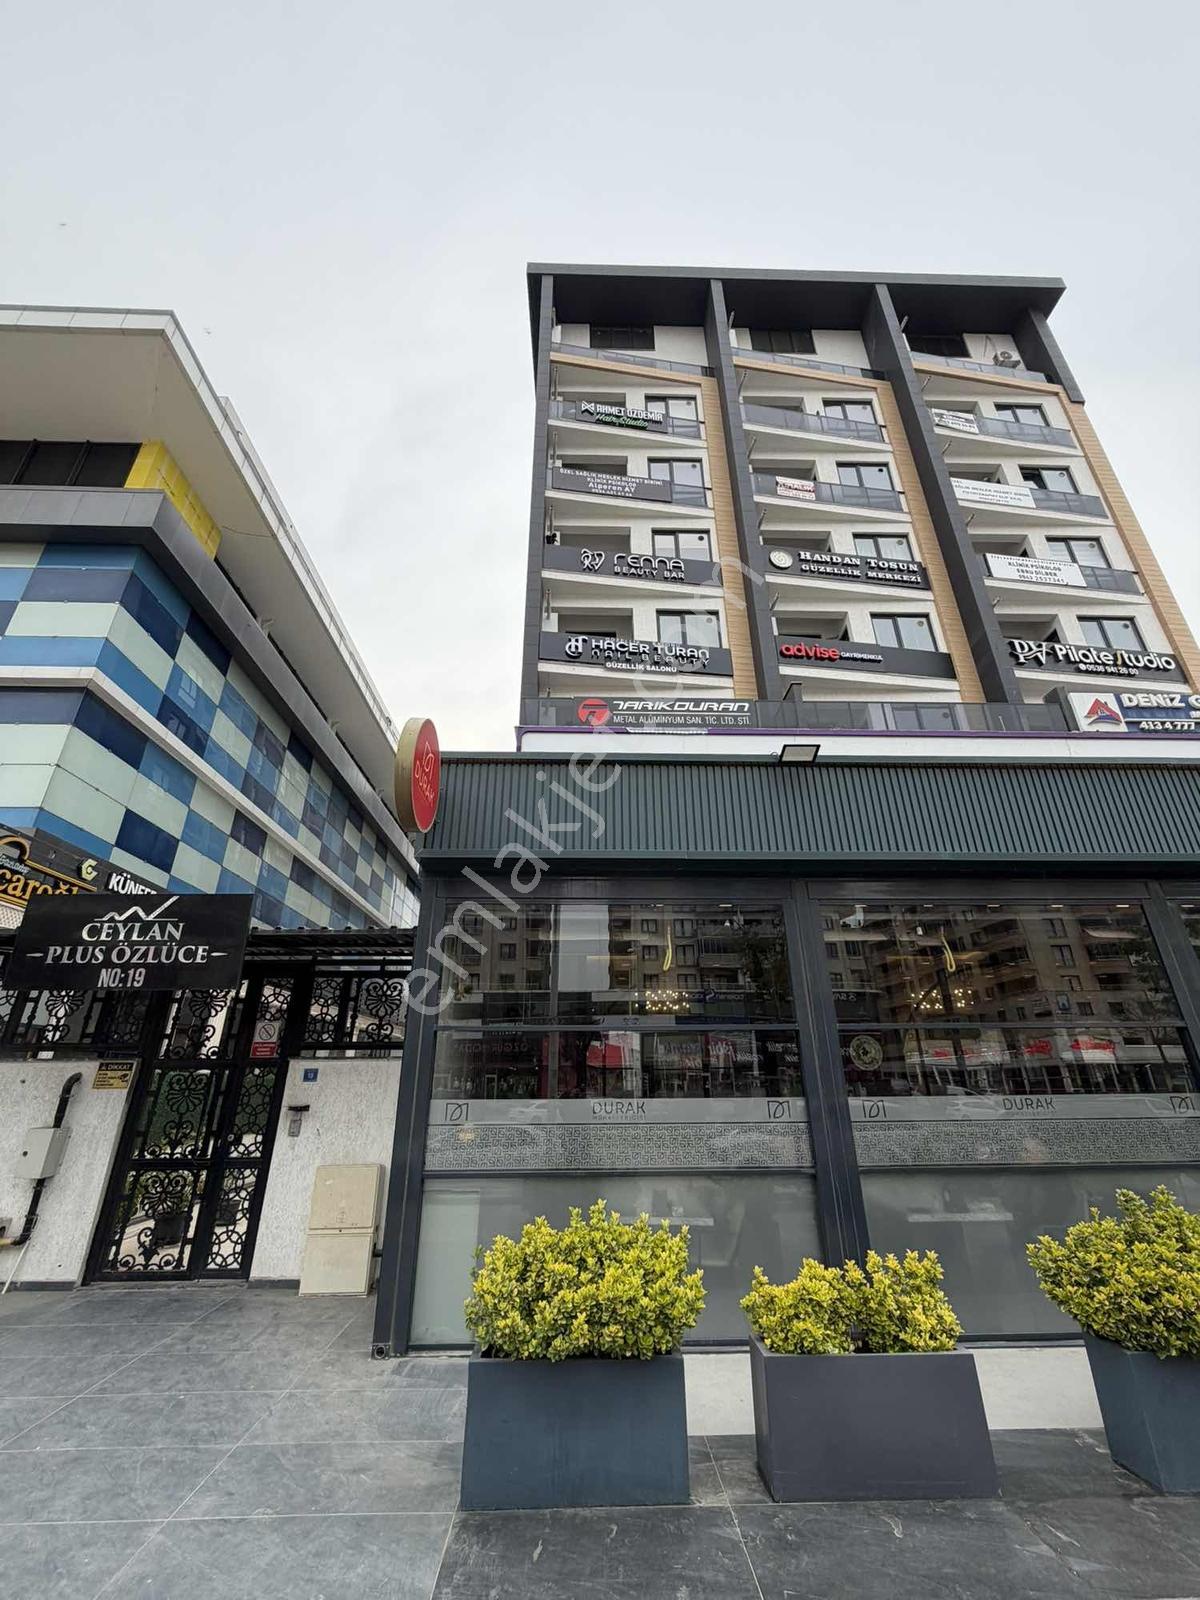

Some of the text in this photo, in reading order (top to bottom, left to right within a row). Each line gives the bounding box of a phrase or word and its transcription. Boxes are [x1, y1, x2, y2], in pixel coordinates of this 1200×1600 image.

[596, 403, 625, 416] AHMET
[588, 482, 623, 492] Alperen
[799, 551, 918, 572] HANDAN TOSUN
[614, 566, 685, 579] BEAUTY BAR
[591, 639, 650, 654] HACER
[781, 642, 840, 660] advise
[642, 652, 711, 665] BEAUTY
[606, 661, 678, 673] GÜZELLİK SALONU
[613, 715, 637, 724] METAL
[720, 716, 737, 725] LTD.
[82, 922, 184, 941] CEYLAN
[45, 942, 209, 964] PLUS ÖZLÜCE
[98, 968, 146, 988] NO:19
[593, 1101, 646, 1114] DURAK
[1002, 1097, 1056, 1110] DURAK
